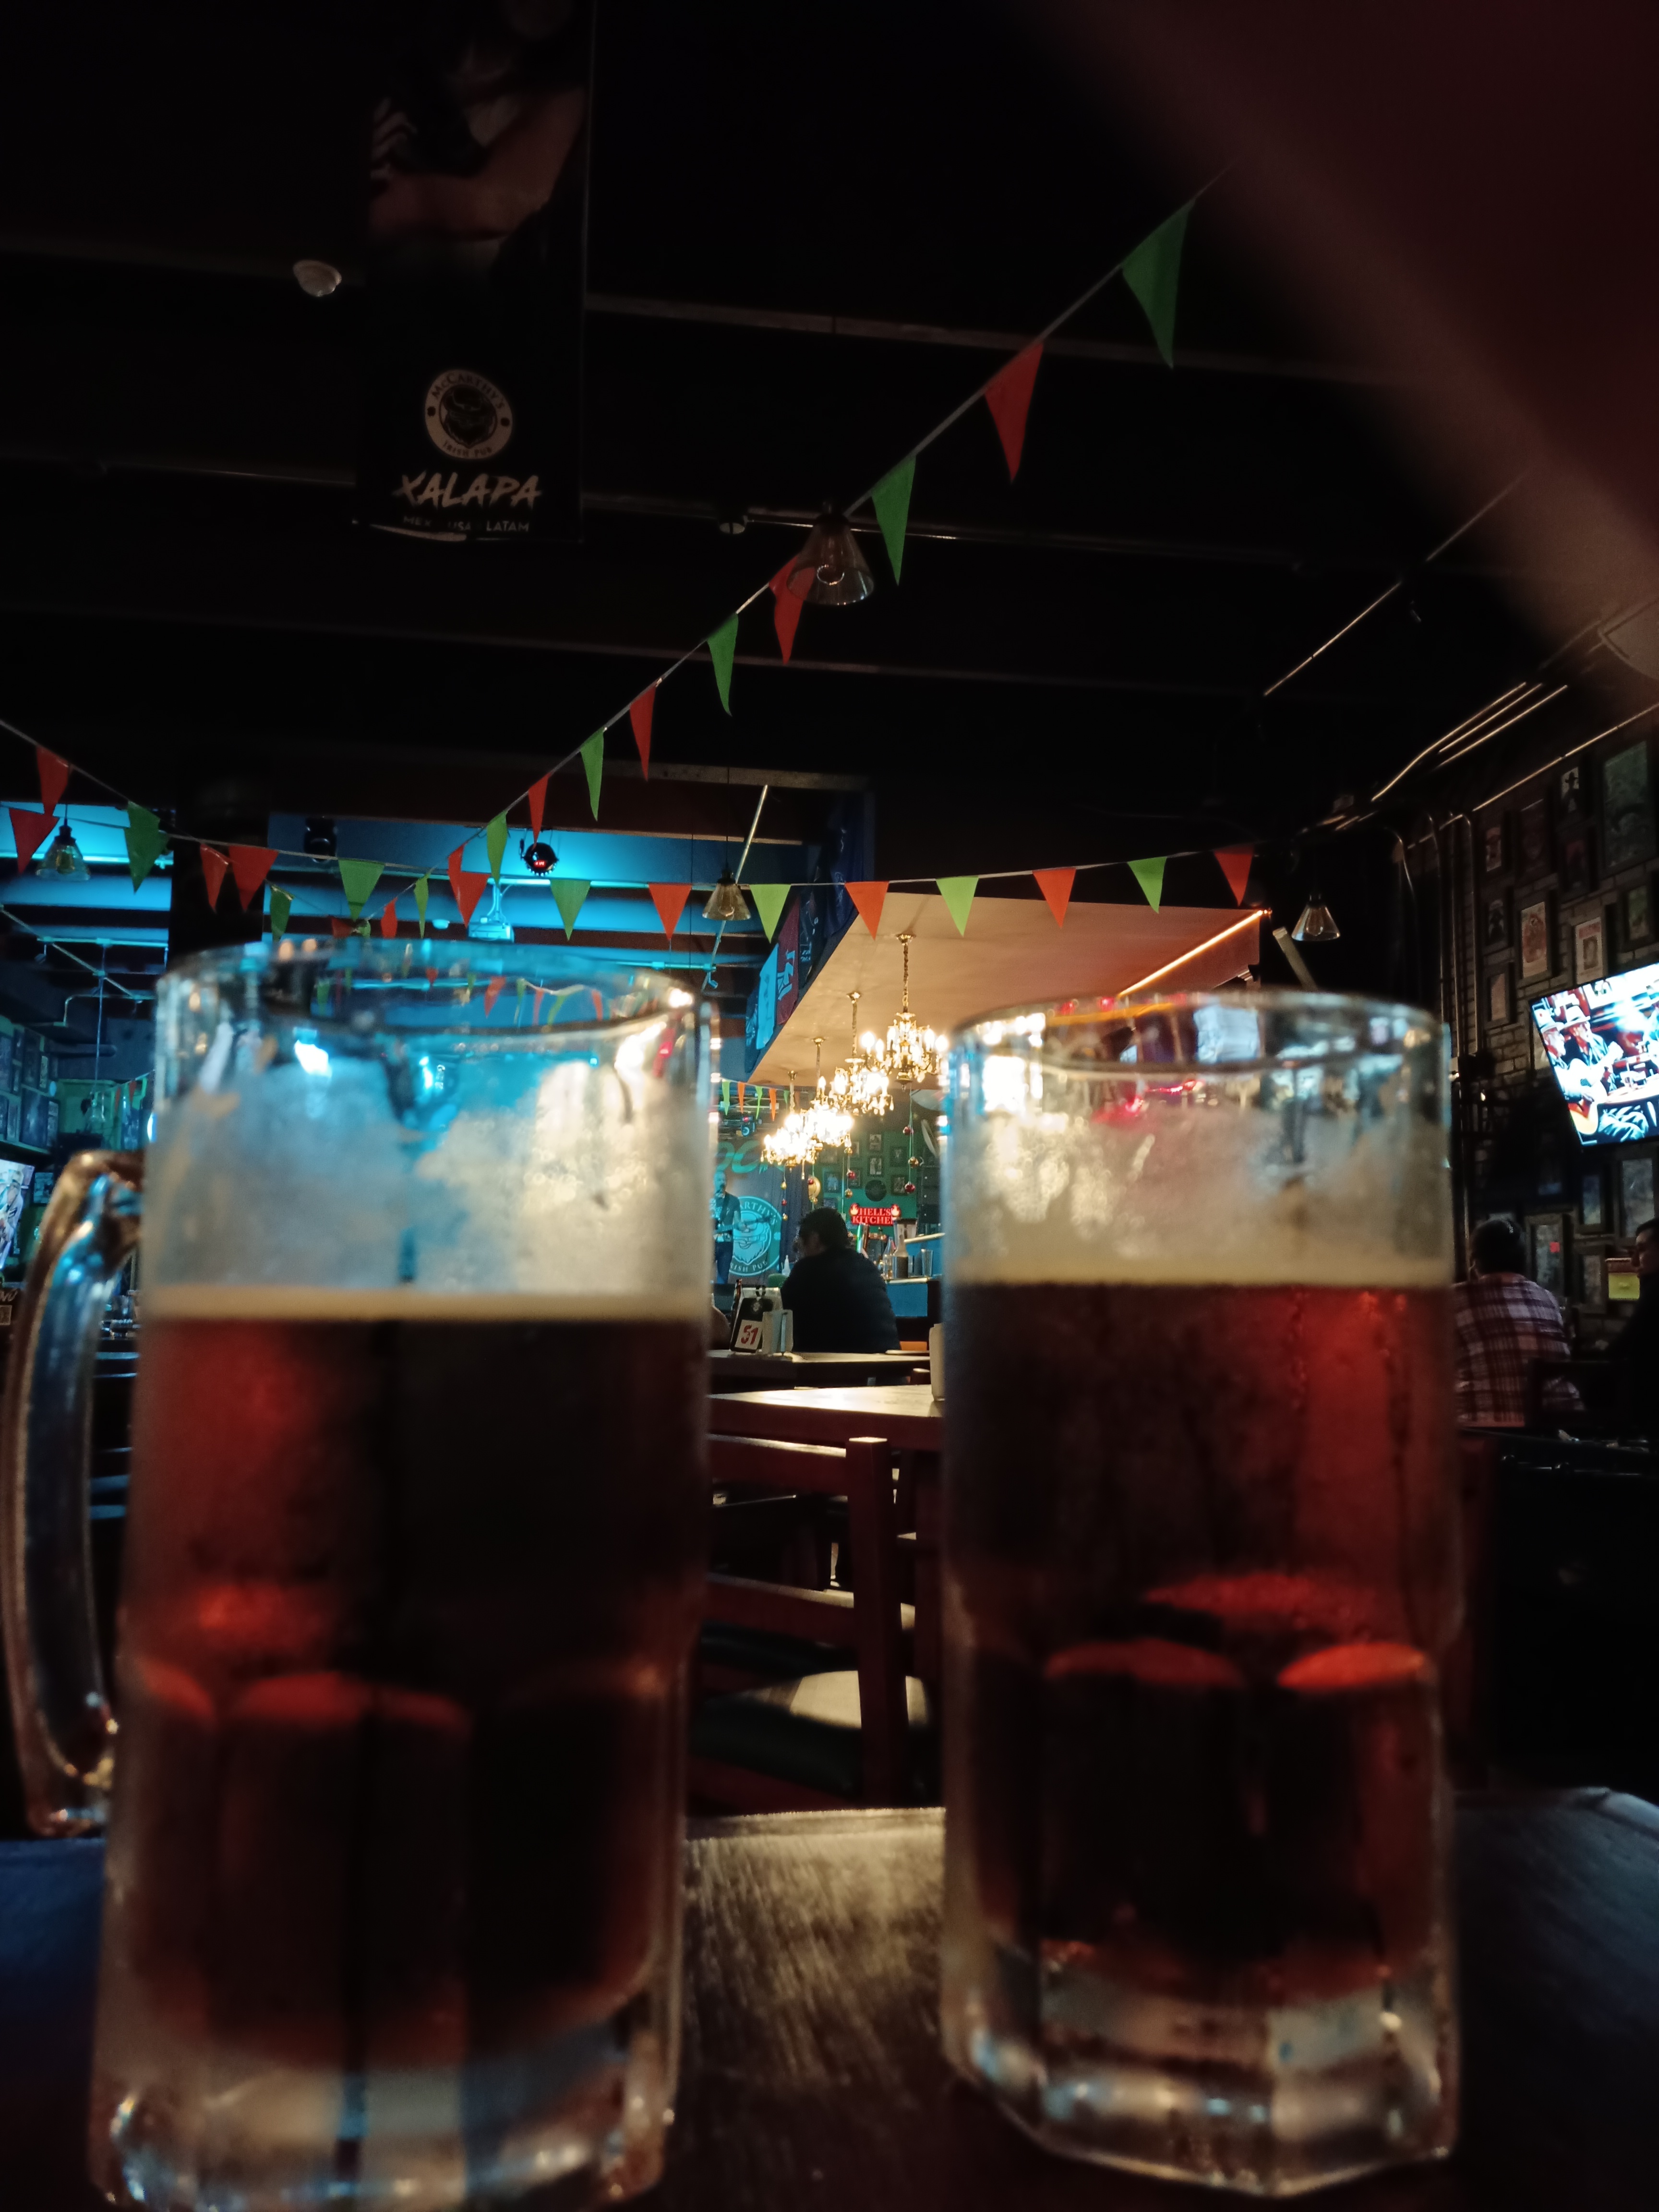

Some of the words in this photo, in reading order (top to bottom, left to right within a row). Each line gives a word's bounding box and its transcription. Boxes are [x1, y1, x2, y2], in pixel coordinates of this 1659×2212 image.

[442, 440, 469, 456] IRISH
[474, 447, 492, 457] PUB
[391, 469, 543, 510] XALAPA
[403, 516, 433, 527] MEX
[447, 521, 472, 531] USA
[485, 520, 530, 532] LATAM
[858, 1208, 891, 1216] HELL'S
[730, 1262, 748, 1273] RISH
[741, 1324, 759, 1345] 51
